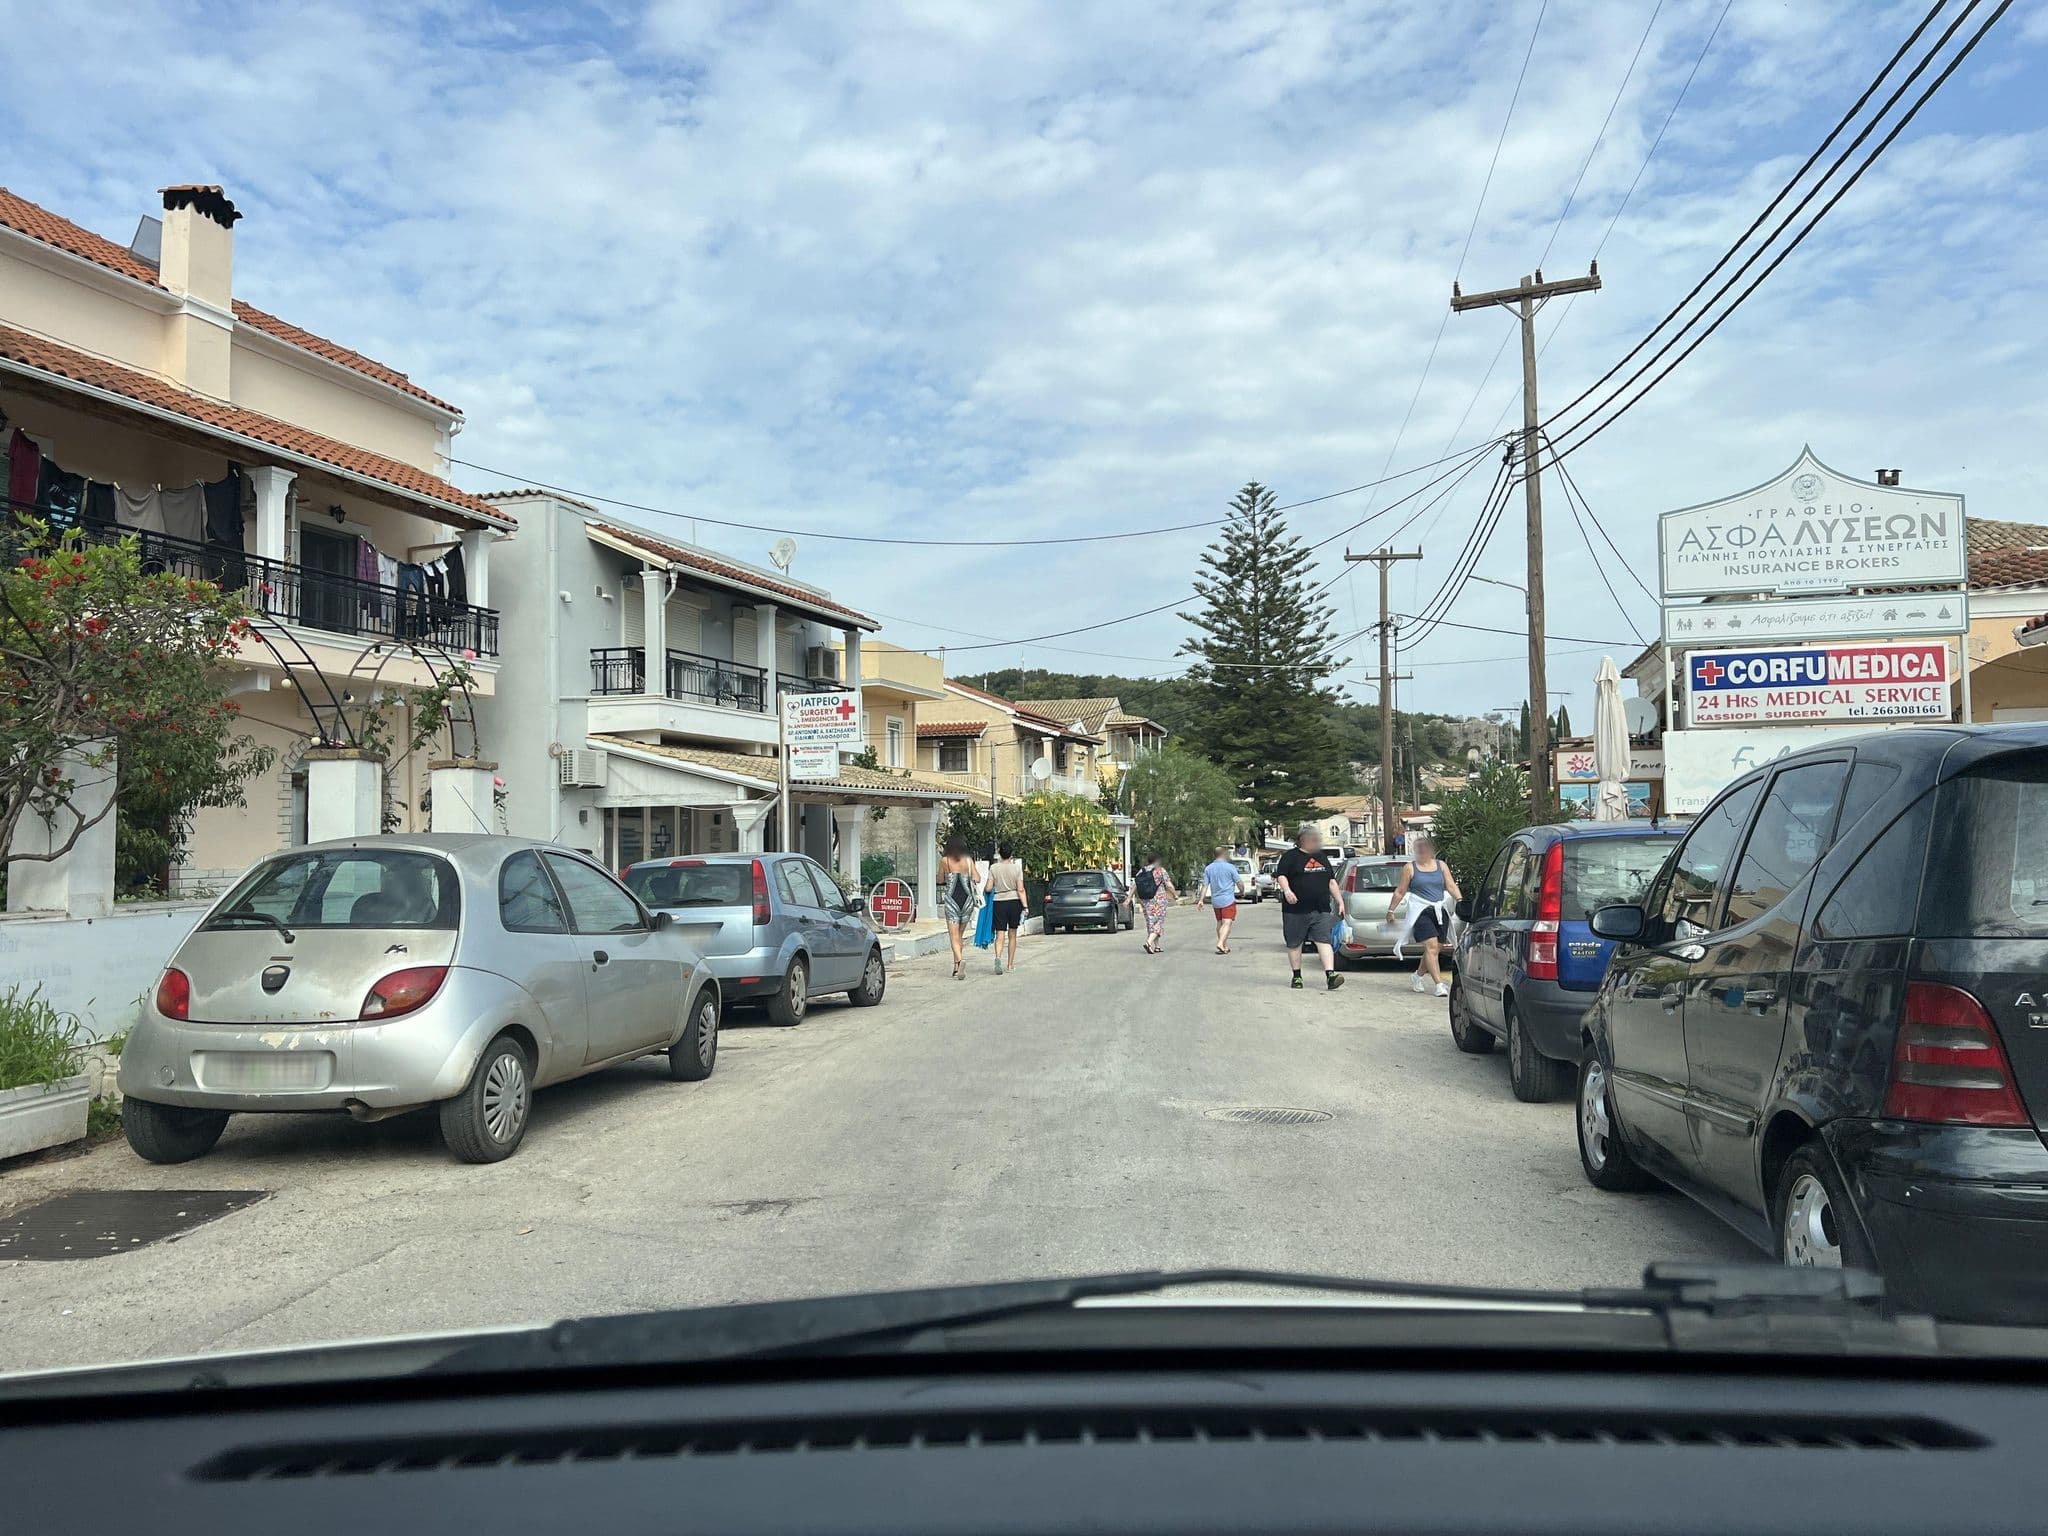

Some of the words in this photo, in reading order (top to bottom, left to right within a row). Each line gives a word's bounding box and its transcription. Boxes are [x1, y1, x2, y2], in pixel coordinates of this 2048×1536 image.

[1755, 503, 1863, 519] ΓΡΑΦΕΙΟ
[1748, 546, 1831, 560] ΠΟΥΛΙΑΣΗΣ
[1841, 546, 1848, 554] &
[1724, 561, 1820, 576] INSURANCE
[1825, 556, 1900, 571] BROKERS
[1727, 653, 1939, 684] CORFUMEDICA
[801, 696, 839, 707] ΙΑΤΡΕΙΟ
[1697, 695, 1719, 709] 24
[1766, 689, 1854, 706] MEDICAL
[1865, 687, 1941, 704] SERVICE
[800, 708, 834, 716] SURGERY
[1696, 712, 1757, 721] KASSIOPI
[1765, 710, 1827, 719] SURGERY
[1849, 706, 1869, 716] tel.
[1872, 705, 1942, 715] 2663081661
